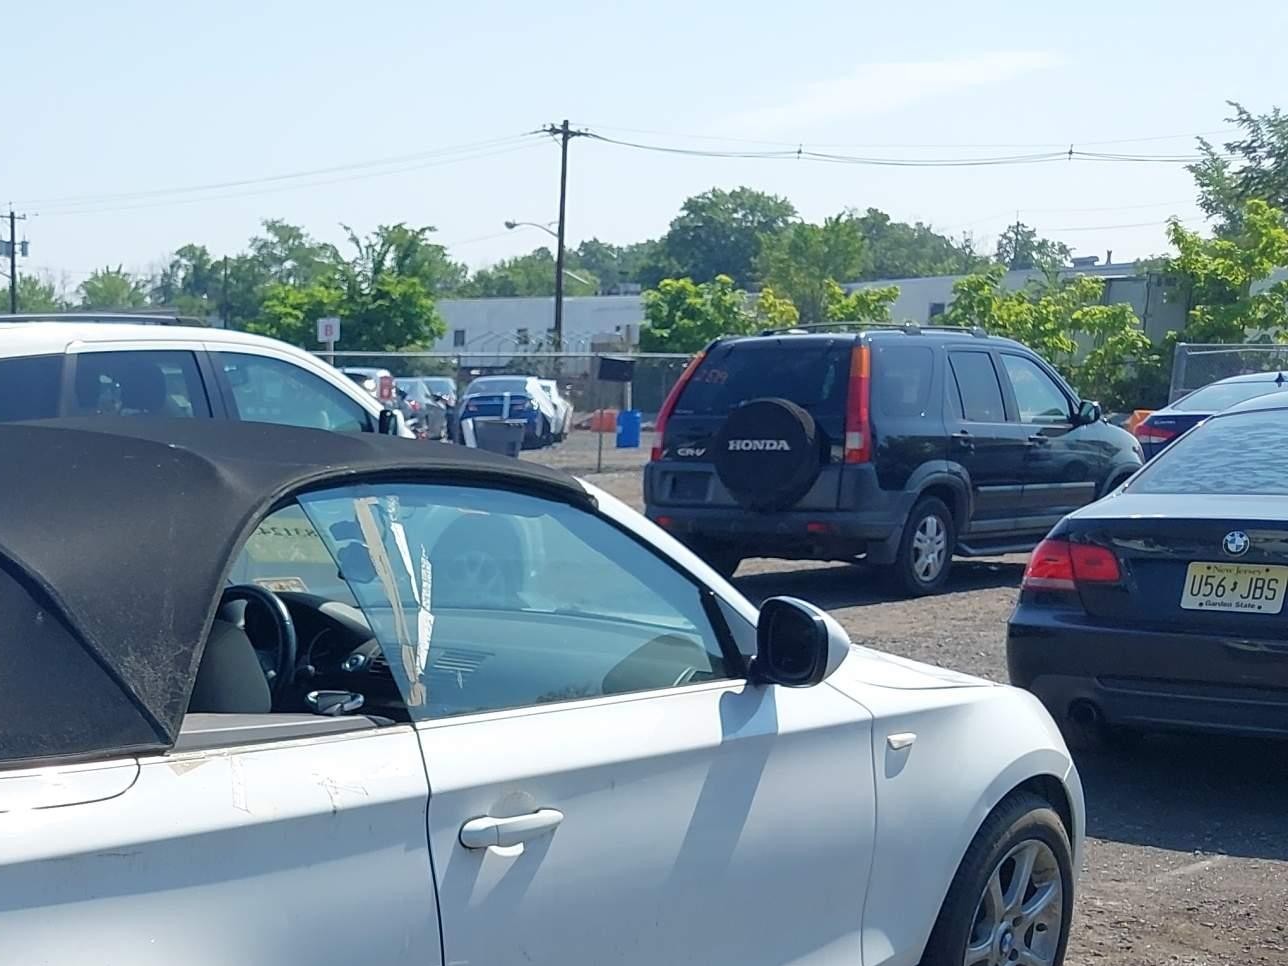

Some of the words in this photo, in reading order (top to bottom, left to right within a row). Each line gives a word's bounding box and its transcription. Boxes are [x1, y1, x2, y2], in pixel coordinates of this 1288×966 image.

[728, 440, 791, 451] HONDA
[1211, 565, 1232, 574] New
[1236, 566, 1262, 576] Jersey
[1190, 574, 1227, 598] U56
[1239, 576, 1279, 601] JBS
[1205, 600, 1232, 608] Garden
[1235, 601, 1256, 609] State
